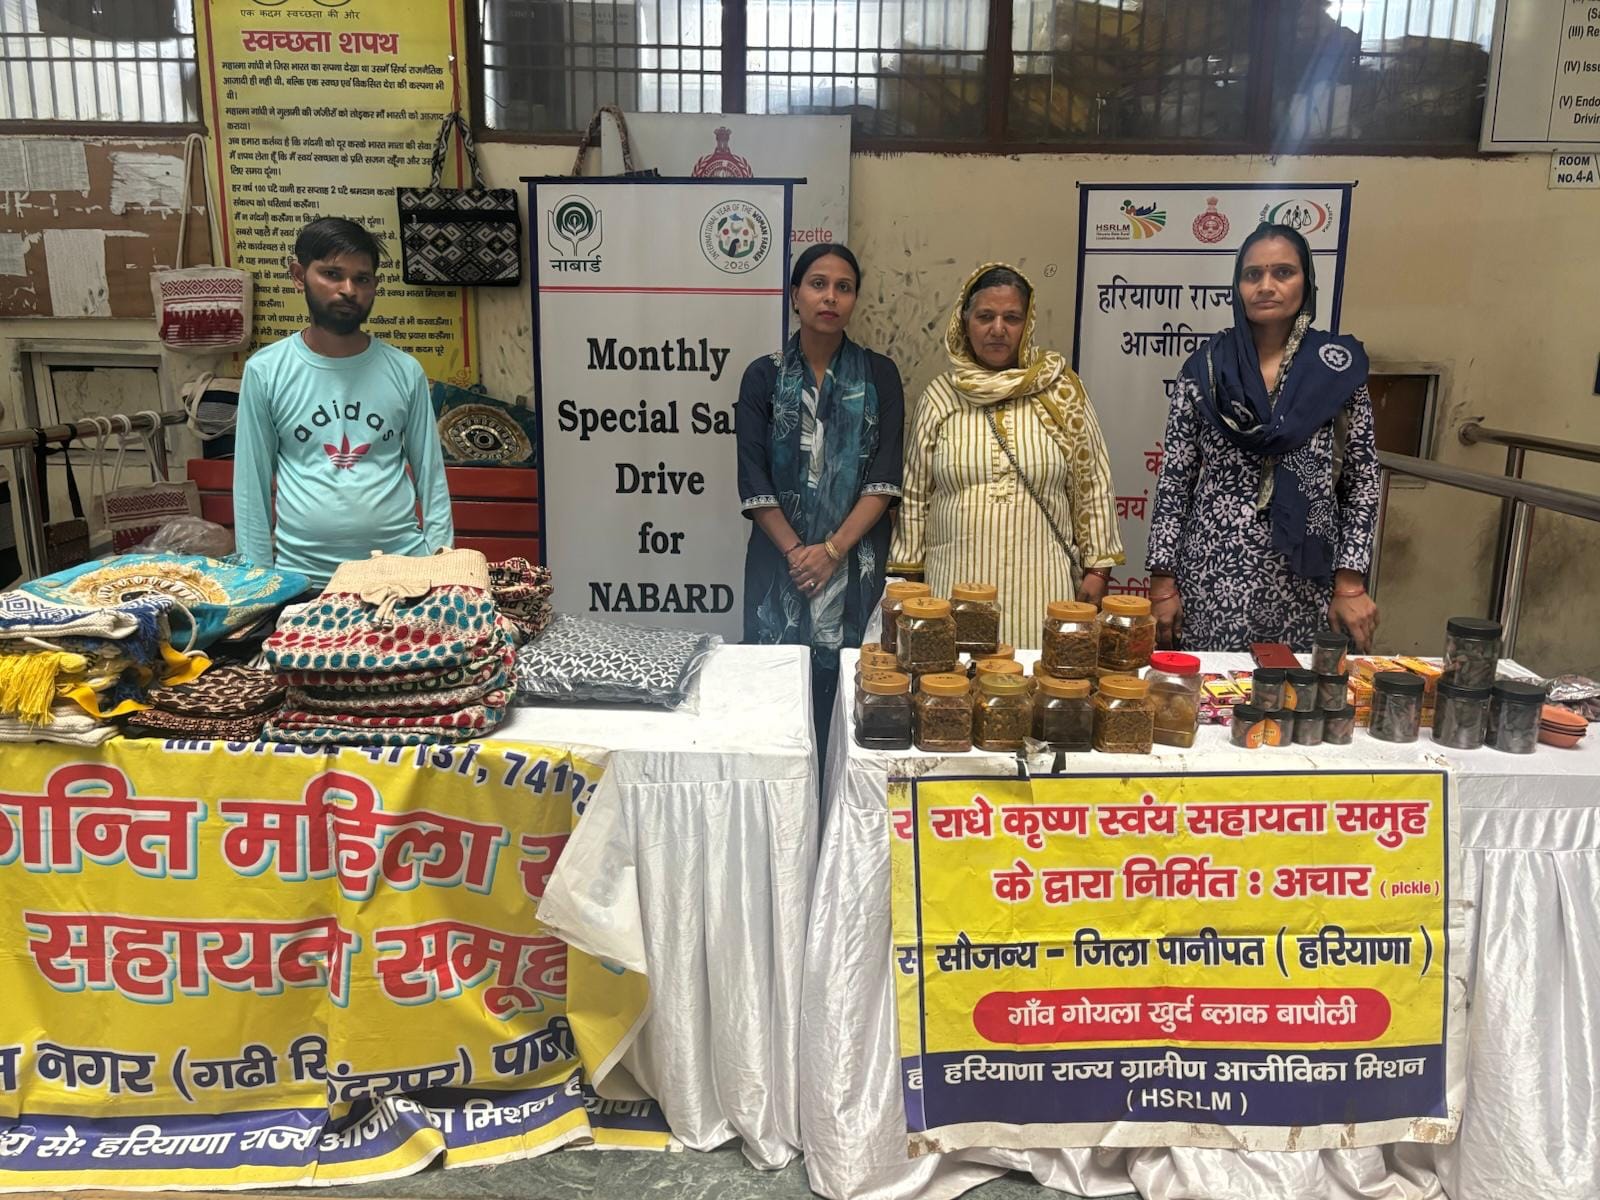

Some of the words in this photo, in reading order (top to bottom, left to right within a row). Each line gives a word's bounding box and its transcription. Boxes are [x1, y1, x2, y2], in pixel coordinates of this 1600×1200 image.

[286, 10, 322, 18] स्वच्छता
[328, 9, 338, 18] की
[344, 9, 360, 19] ओर
[241, 30, 332, 52] स्वच्छता
[338, 32, 399, 55] शपथ
[1568, 25, 1584, 39] (III)
[222, 61, 246, 70] महात्मा
[266, 59, 272, 70] ने
[273, 60, 289, 70] जिस
[291, 63, 309, 71] भारत
[310, 63, 320, 71] का
[322, 63, 342, 72] सपना
[344, 62, 359, 72] देखा
[361, 64, 369, 72] था
[391, 63, 407, 74] सिर्फ
[409, 64, 444, 75] राजनैतिक
[1564, 61, 1580, 74] (IV)
[223, 75, 248, 86] आजादी
[249, 75, 257, 86] ही
[286, 76, 305, 86] बल्कि
[306, 78, 318, 86] एक
[353, 77, 381, 88] विकसित
[384, 79, 395, 89] देश
[397, 78, 407, 89] की
[409, 82, 433, 90] कल्पना
[435, 80, 444, 90] भी
[225, 107, 249, 116] महात्मा
[269, 106, 275, 116] ने
[277, 106, 300, 119] गुलामी
[302, 107, 311, 116] की
[338, 108, 348, 118] को
[386, 109, 406, 119] भारती
[408, 109, 418, 119] को
[1559, 96, 1572, 109] (V)
[230, 165, 243, 175] लिए
[245, 167, 262, 175] समय
[1559, 157, 1590, 166] ROOM
[232, 184, 241, 193] हर
[279, 184, 294, 194] यानी
[296, 186, 306, 194] हर
[307, 186, 328, 195] सप्ताह
[331, 186, 336, 194] 2
[377, 187, 395, 196] करके
[717, 204, 731, 216] YEAR
[732, 203, 740, 211] OF
[742, 204, 753, 214] THE
[752, 210, 768, 235] WOMAN
[790, 227, 833, 242] azette
[704, 215, 719, 260] INTERNATIONAL
[753, 237, 768, 262] FARMER
[549, 256, 601, 273] नाबार्ड
[724, 261, 750, 270] 2026
[1097, 275, 1183, 313] हरियाणा
[587, 337, 730, 381] Monthly
[294, 400, 394, 442] adidas
[558, 399, 679, 441] Special
[691, 402, 738, 435] Sal
[615, 461, 705, 495] Drive
[1115, 489, 1148, 520] वयं
[638, 521, 684, 554] for
[588, 582, 734, 613] NABARD
[221, 771, 503, 893] महिला
[931, 796, 993, 838] राधे
[1002, 806, 1089, 848] कृष्ण
[1098, 794, 1177, 835] स्वंय
[1186, 803, 1327, 836] सहायता
[1335, 802, 1429, 848] समुह
[994, 860, 1033, 900] के
[1043, 870, 1114, 903] द्वारा
[1123, 857, 1238, 898] निर्मित
[1273, 867, 1372, 897] अचार
[936, 931, 1039, 972] सौजन्य
[1073, 927, 1151, 967] जिला
[1157, 927, 1265, 965] पानीपत
[1297, 925, 1412, 969] हरियाणा
[376, 921, 567, 1015] समूह
[1008, 998, 1055, 1027] गाँव
[1062, 997, 1141, 1024] गोयला
[1148, 995, 1194, 1033] खुर्द
[1200, 1004, 1269, 1025] ब्लाक
[1276, 995, 1357, 1025] बापौली
[37, 1043, 155, 1093] नगर
[172, 1046, 277, 1102] (गढी
[492, 1016, 576, 1075] पानी
[944, 1055, 1045, 1084] हरियाणा
[1052, 1061, 1114, 1082] राज्य
[1120, 1051, 1207, 1083] ग्रामीण
[1214, 1054, 1348, 1082] आजीविका
[1355, 1053, 1426, 1080] मिशन
[92, 1125, 237, 1158] हरियाणा
[240, 1125, 323, 1152] राज्य
[463, 1092, 558, 1131] मिशन
